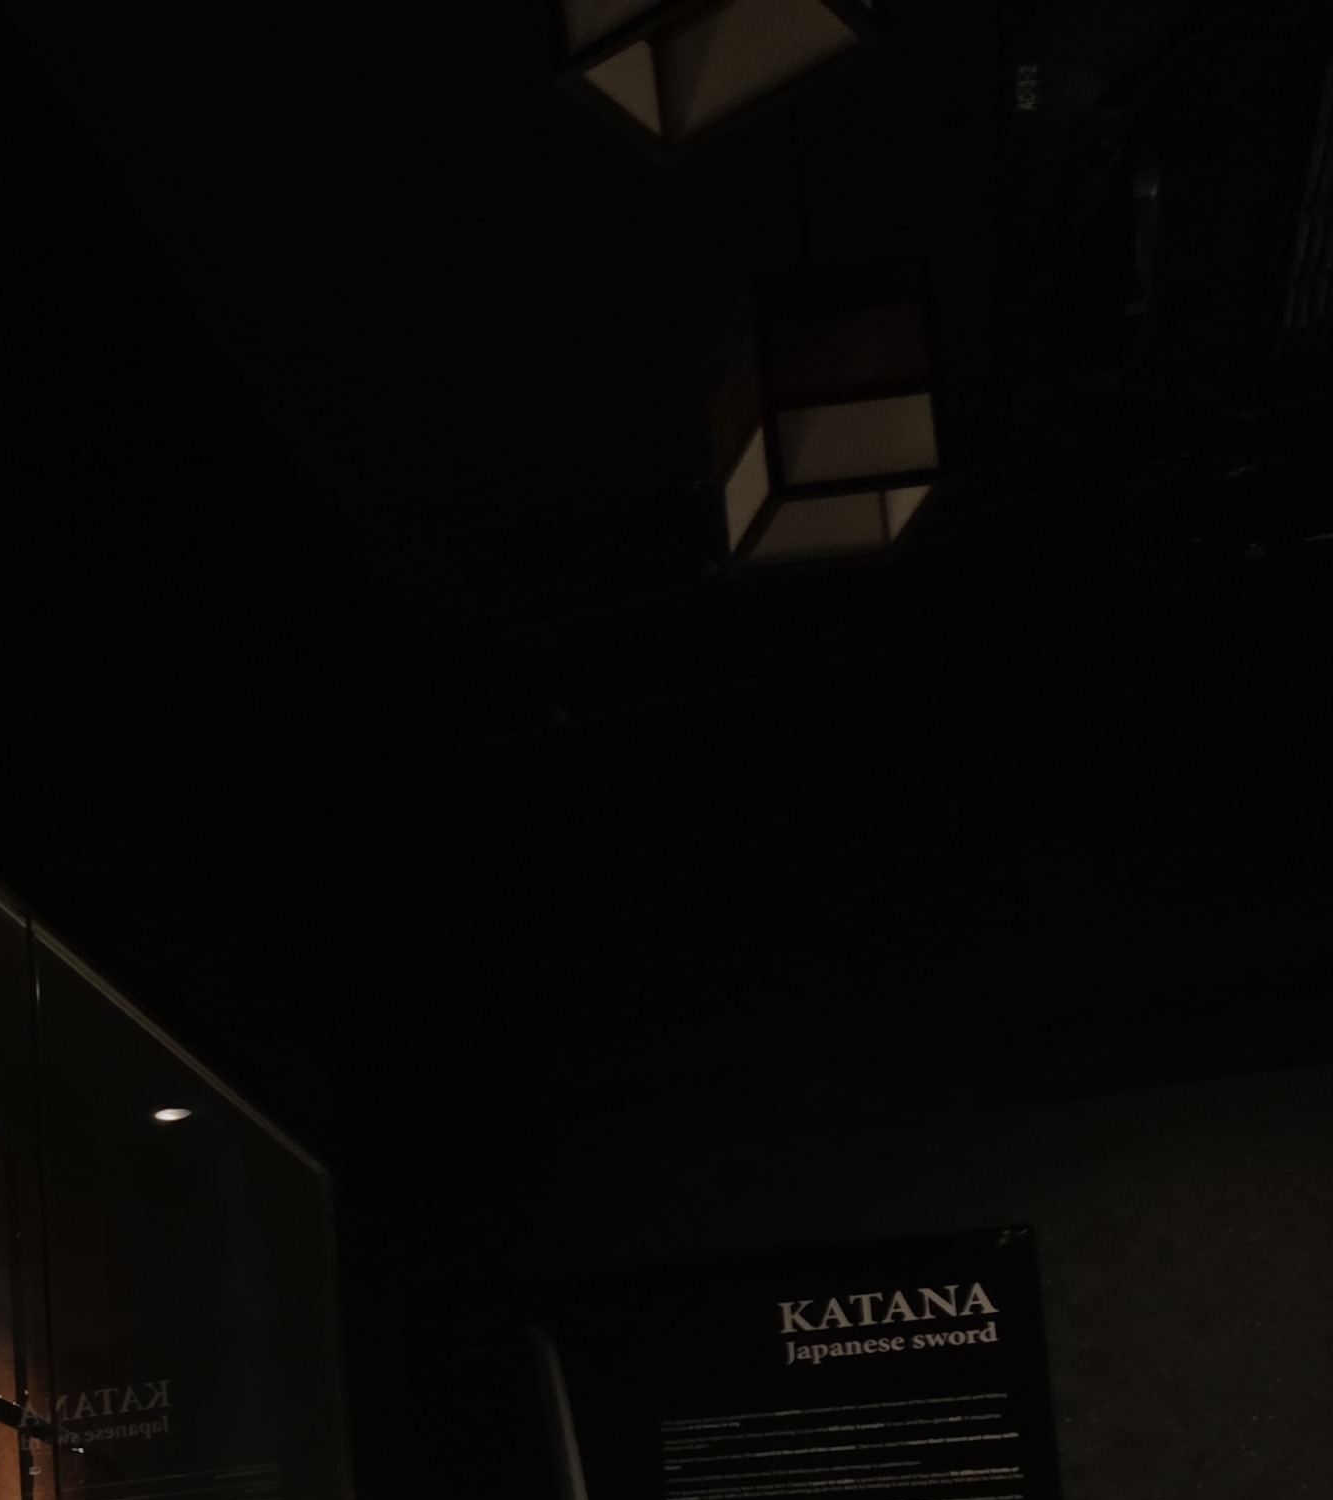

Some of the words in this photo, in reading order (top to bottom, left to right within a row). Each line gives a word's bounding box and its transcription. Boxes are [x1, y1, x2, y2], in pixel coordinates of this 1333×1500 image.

[778, 1282, 1000, 1334] KATANA
[785, 1334, 906, 1365] Japanese
[912, 1321, 999, 1350] sword
